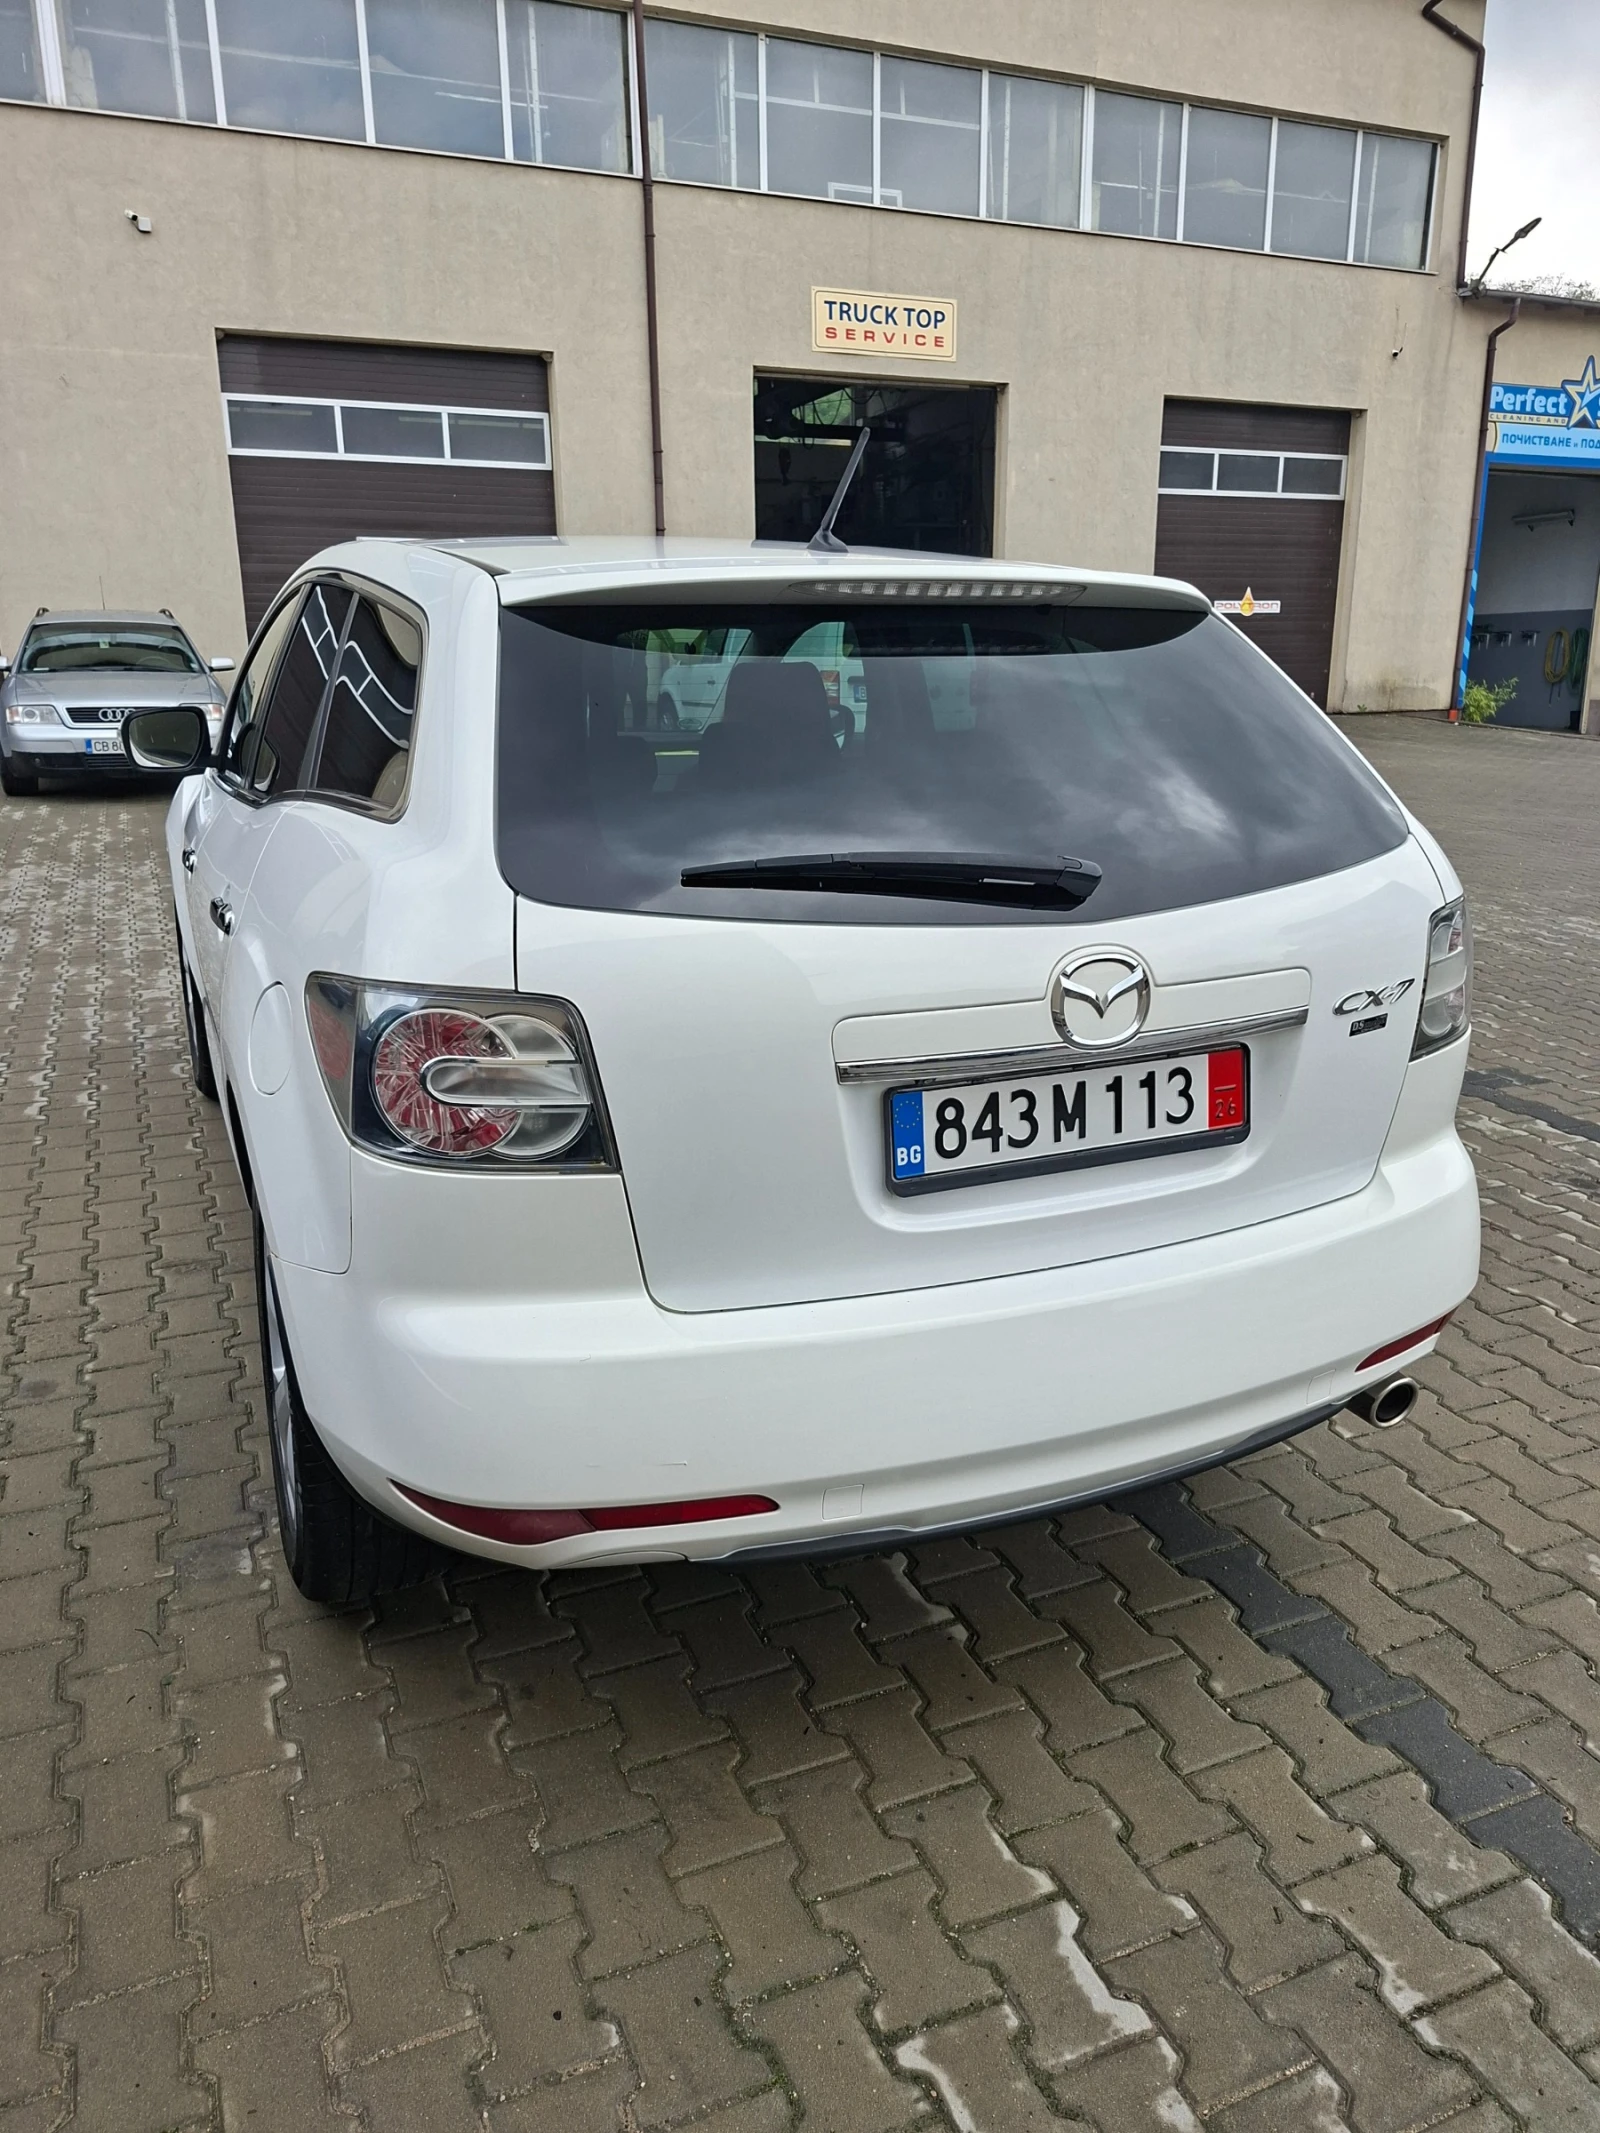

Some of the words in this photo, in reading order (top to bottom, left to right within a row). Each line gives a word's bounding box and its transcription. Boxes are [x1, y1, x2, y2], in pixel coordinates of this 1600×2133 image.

[824, 300, 898, 326] TRUCK
[903, 307, 946, 330] TOP
[825, 327, 945, 348] SERVICE
[1490, 386, 1568, 415] Perfect
[1489, 413, 1541, 423] CLEANING
[1546, 417, 1567, 425] AND
[1502, 433, 1572, 448] ПОЧИСТВАНЕ
[1215, 602, 1279, 610] POLYTRON
[94, 741, 109, 752] CB
[1332, 977, 1415, 1016] CX-7
[934, 1088, 1039, 1160] 843
[1052, 1080, 1087, 1144] M
[1105, 1066, 1195, 1135] 113
[1215, 1096, 1237, 1119] 26
[896, 1145, 922, 1167] BG
